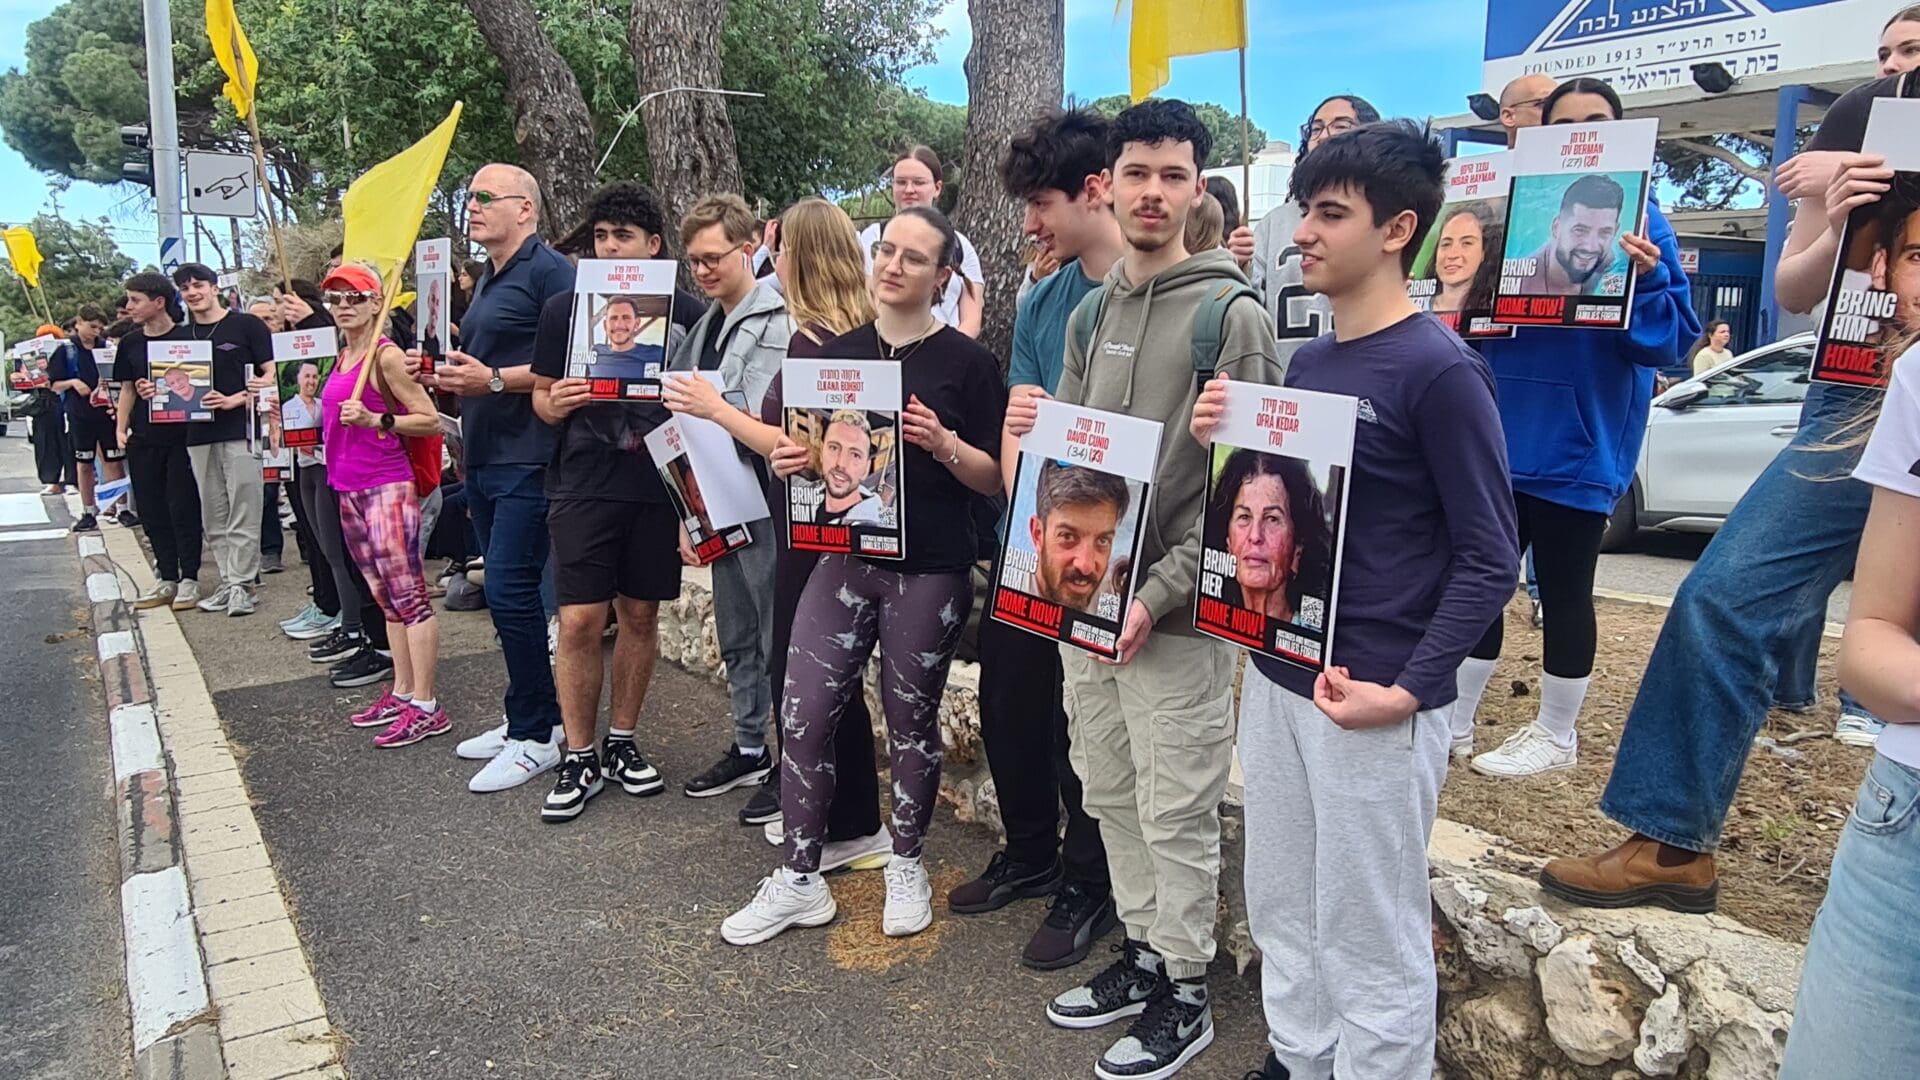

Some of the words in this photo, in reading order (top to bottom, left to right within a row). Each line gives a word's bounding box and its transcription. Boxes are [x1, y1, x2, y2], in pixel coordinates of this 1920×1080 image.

[1577, 0, 1620, 33] לכת
[1725, 28, 1767, 45] נוסד
[1524, 54, 1596, 76] FOUNDED
[1605, 47, 1643, 64] 1913
[1744, 54, 1779, 75] בית
[1620, 66, 1681, 90] הריאלי
[1561, 145, 1573, 156] ZIV
[1573, 143, 1604, 155] BERMAN
[1502, 258, 1537, 276] BRING
[1498, 277, 1522, 295] HIM
[1495, 296, 1528, 315] HOME
[1529, 295, 1565, 316] NOW!
[1835, 288, 1898, 318] BRING
[1829, 315, 1869, 342] HIM
[1823, 343, 1876, 373] HOME
[1256, 412, 1274, 428] OFRA
[1276, 416, 1300, 432] KEDAR
[1066, 428, 1088, 445] DAVID
[1088, 434, 1110, 450] CUNIO
[1268, 430, 1283, 448] (70)
[1067, 444, 1088, 462] (34)
[791, 486, 819, 504] BRING
[791, 504, 810, 522] HIM
[792, 524, 820, 542] HOME
[821, 526, 850, 545] NOW!
[1005, 545, 1039, 574] BRING
[1203, 547, 1237, 578] BRING
[1001, 566, 1024, 591] HIM
[1201, 570, 1223, 598] HER
[997, 588, 1028, 617] HOME
[1029, 600, 1063, 629] NOW!
[1199, 596, 1230, 627] HOME
[1231, 607, 1266, 639] NOW!
